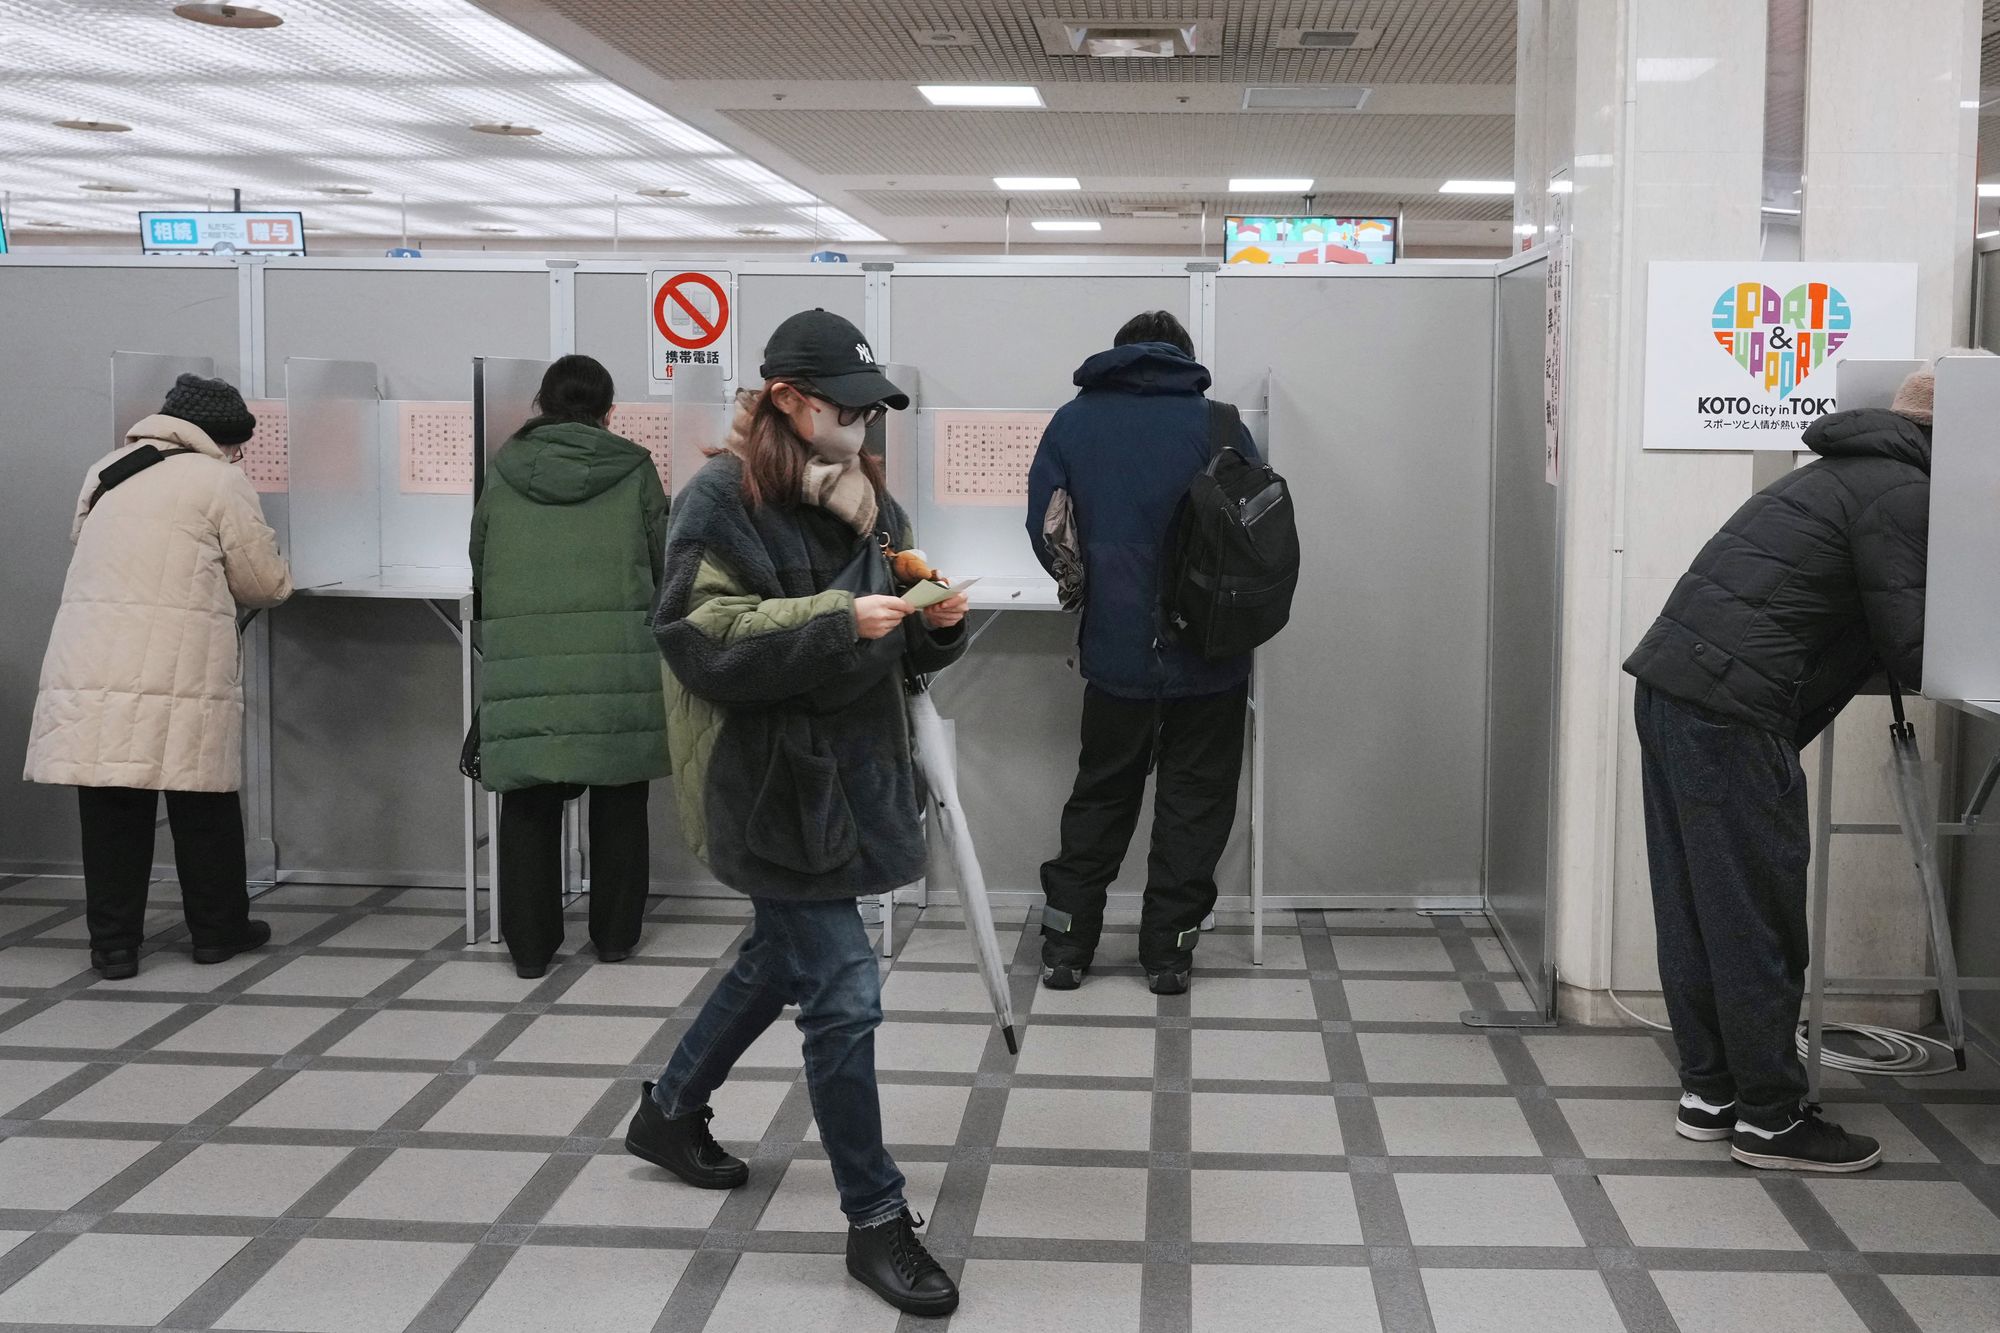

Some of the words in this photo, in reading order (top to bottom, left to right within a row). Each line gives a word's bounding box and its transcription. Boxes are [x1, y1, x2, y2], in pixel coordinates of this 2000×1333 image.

[153, 222, 192, 241] 相続
[252, 222, 289, 241] 贈与
[1712, 282, 1851, 329] SPORTS
[1769, 326, 1793, 349] &
[665, 350, 719, 364] 携帯電話
[855, 343, 874, 363] NY
[1713, 332, 1849, 400] SUPPORTS
[1698, 397, 1751, 415] KOTO
[1752, 404, 1776, 416] City
[1779, 404, 1790, 415] in
